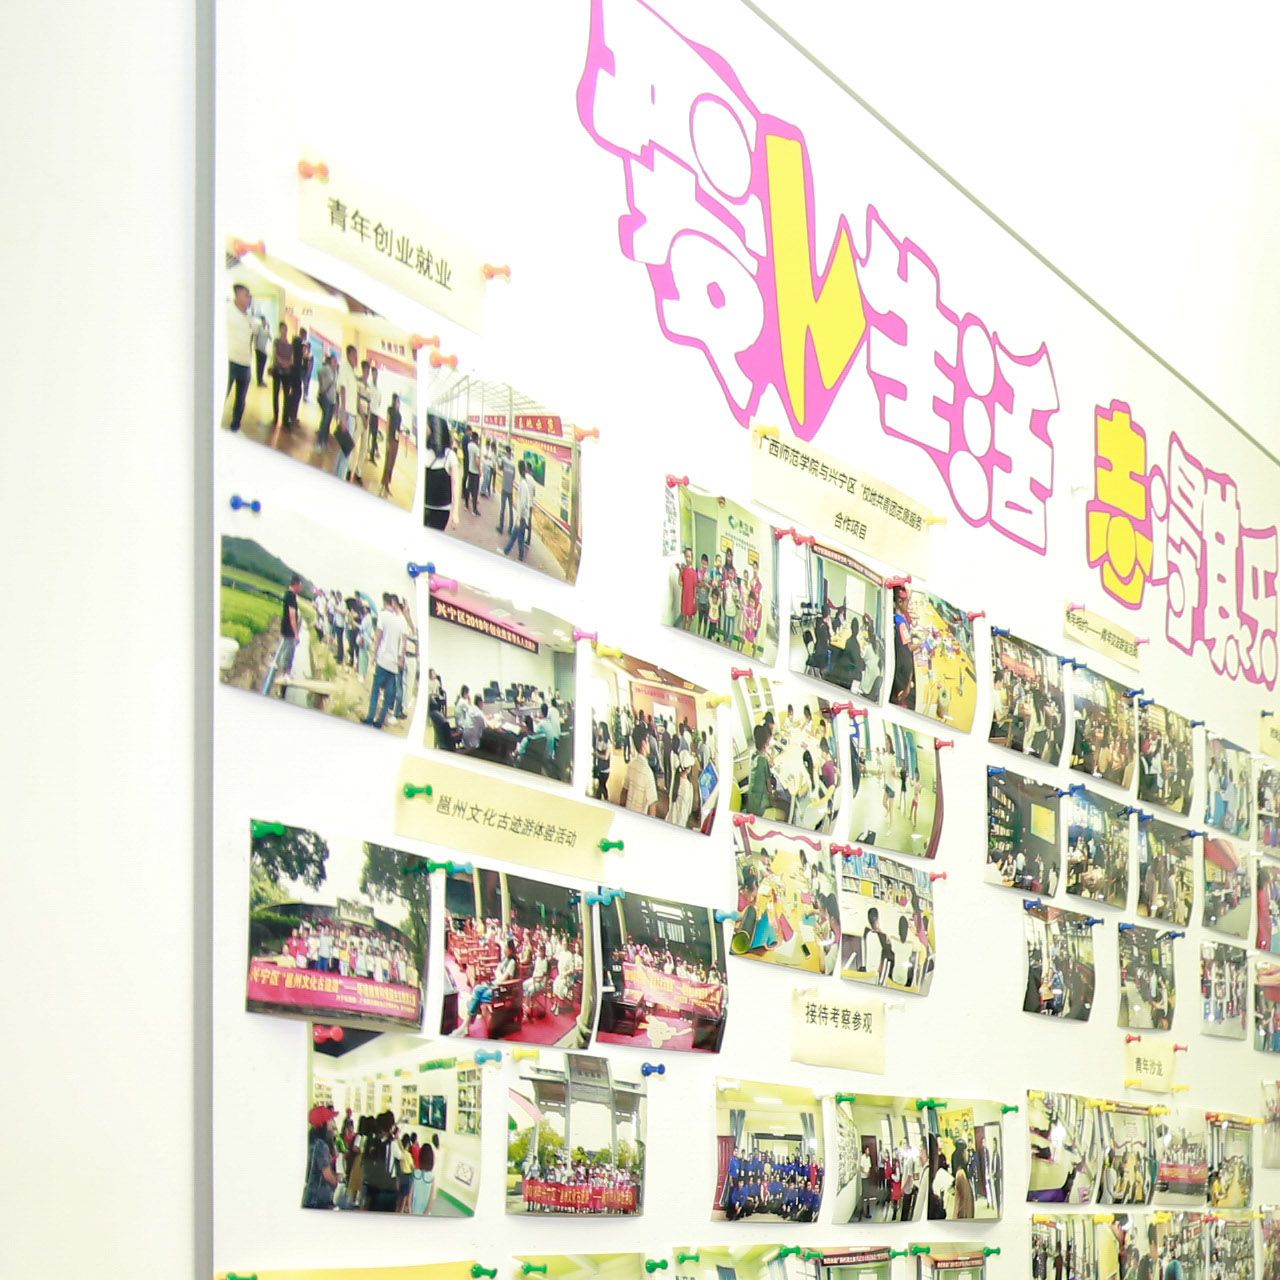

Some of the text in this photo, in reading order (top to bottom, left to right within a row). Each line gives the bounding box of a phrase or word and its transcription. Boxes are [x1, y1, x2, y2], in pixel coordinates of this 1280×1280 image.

[326, 196, 454, 291] 青年创业就业
[833, 511, 868, 541] 合作项目
[434, 792, 578, 851] 邕州文化古迹游体验活动
[804, 1000, 874, 1035] 接待考察参观
[1134, 1057, 1164, 1077] 青年沙龙
